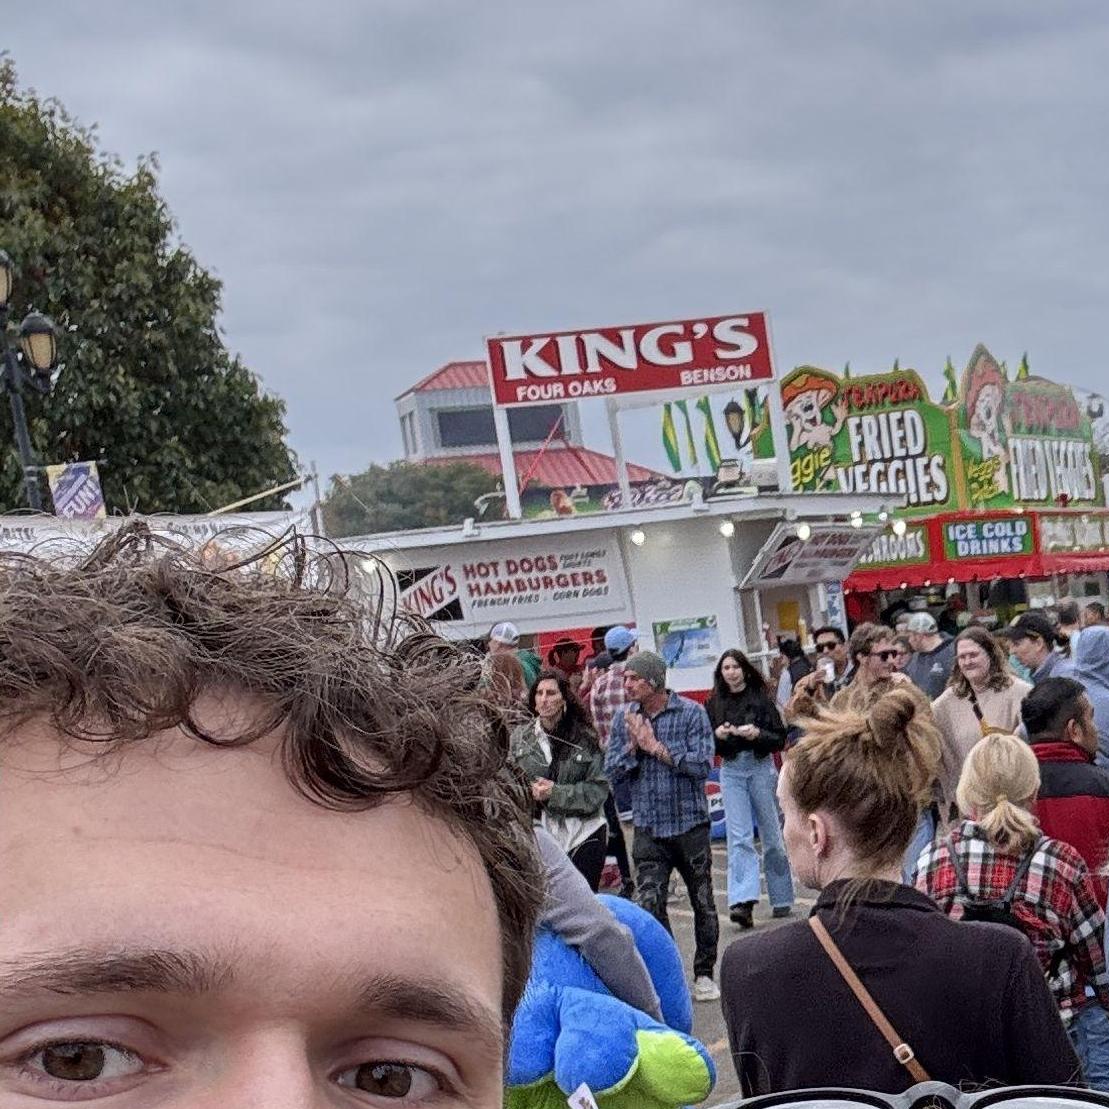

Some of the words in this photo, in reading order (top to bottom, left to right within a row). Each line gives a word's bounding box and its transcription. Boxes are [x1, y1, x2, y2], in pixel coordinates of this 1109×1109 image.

[500, 318, 760, 382] KING'S
[680, 363, 752, 386] BENSON
[516, 381, 566, 402] FOUR
[567, 377, 617, 398] OAKS
[847, 409, 926, 463] FRIED
[836, 454, 949, 504] VEGGIES
[949, 522, 977, 541] ICE
[982, 520, 1028, 538] COLD
[957, 536, 1024, 557] DRINKS
[462, 561, 501, 580] HOT
[505, 553, 559, 577] DOGS
[402, 564, 458, 616] KING'S
[467, 568, 609, 598] HAMBURGERS
[471, 596, 510, 609] FRENCH
[511, 593, 541, 606] FRIES
[552, 589, 579, 602] CORN
[581, 585, 610, 598] DOGS
